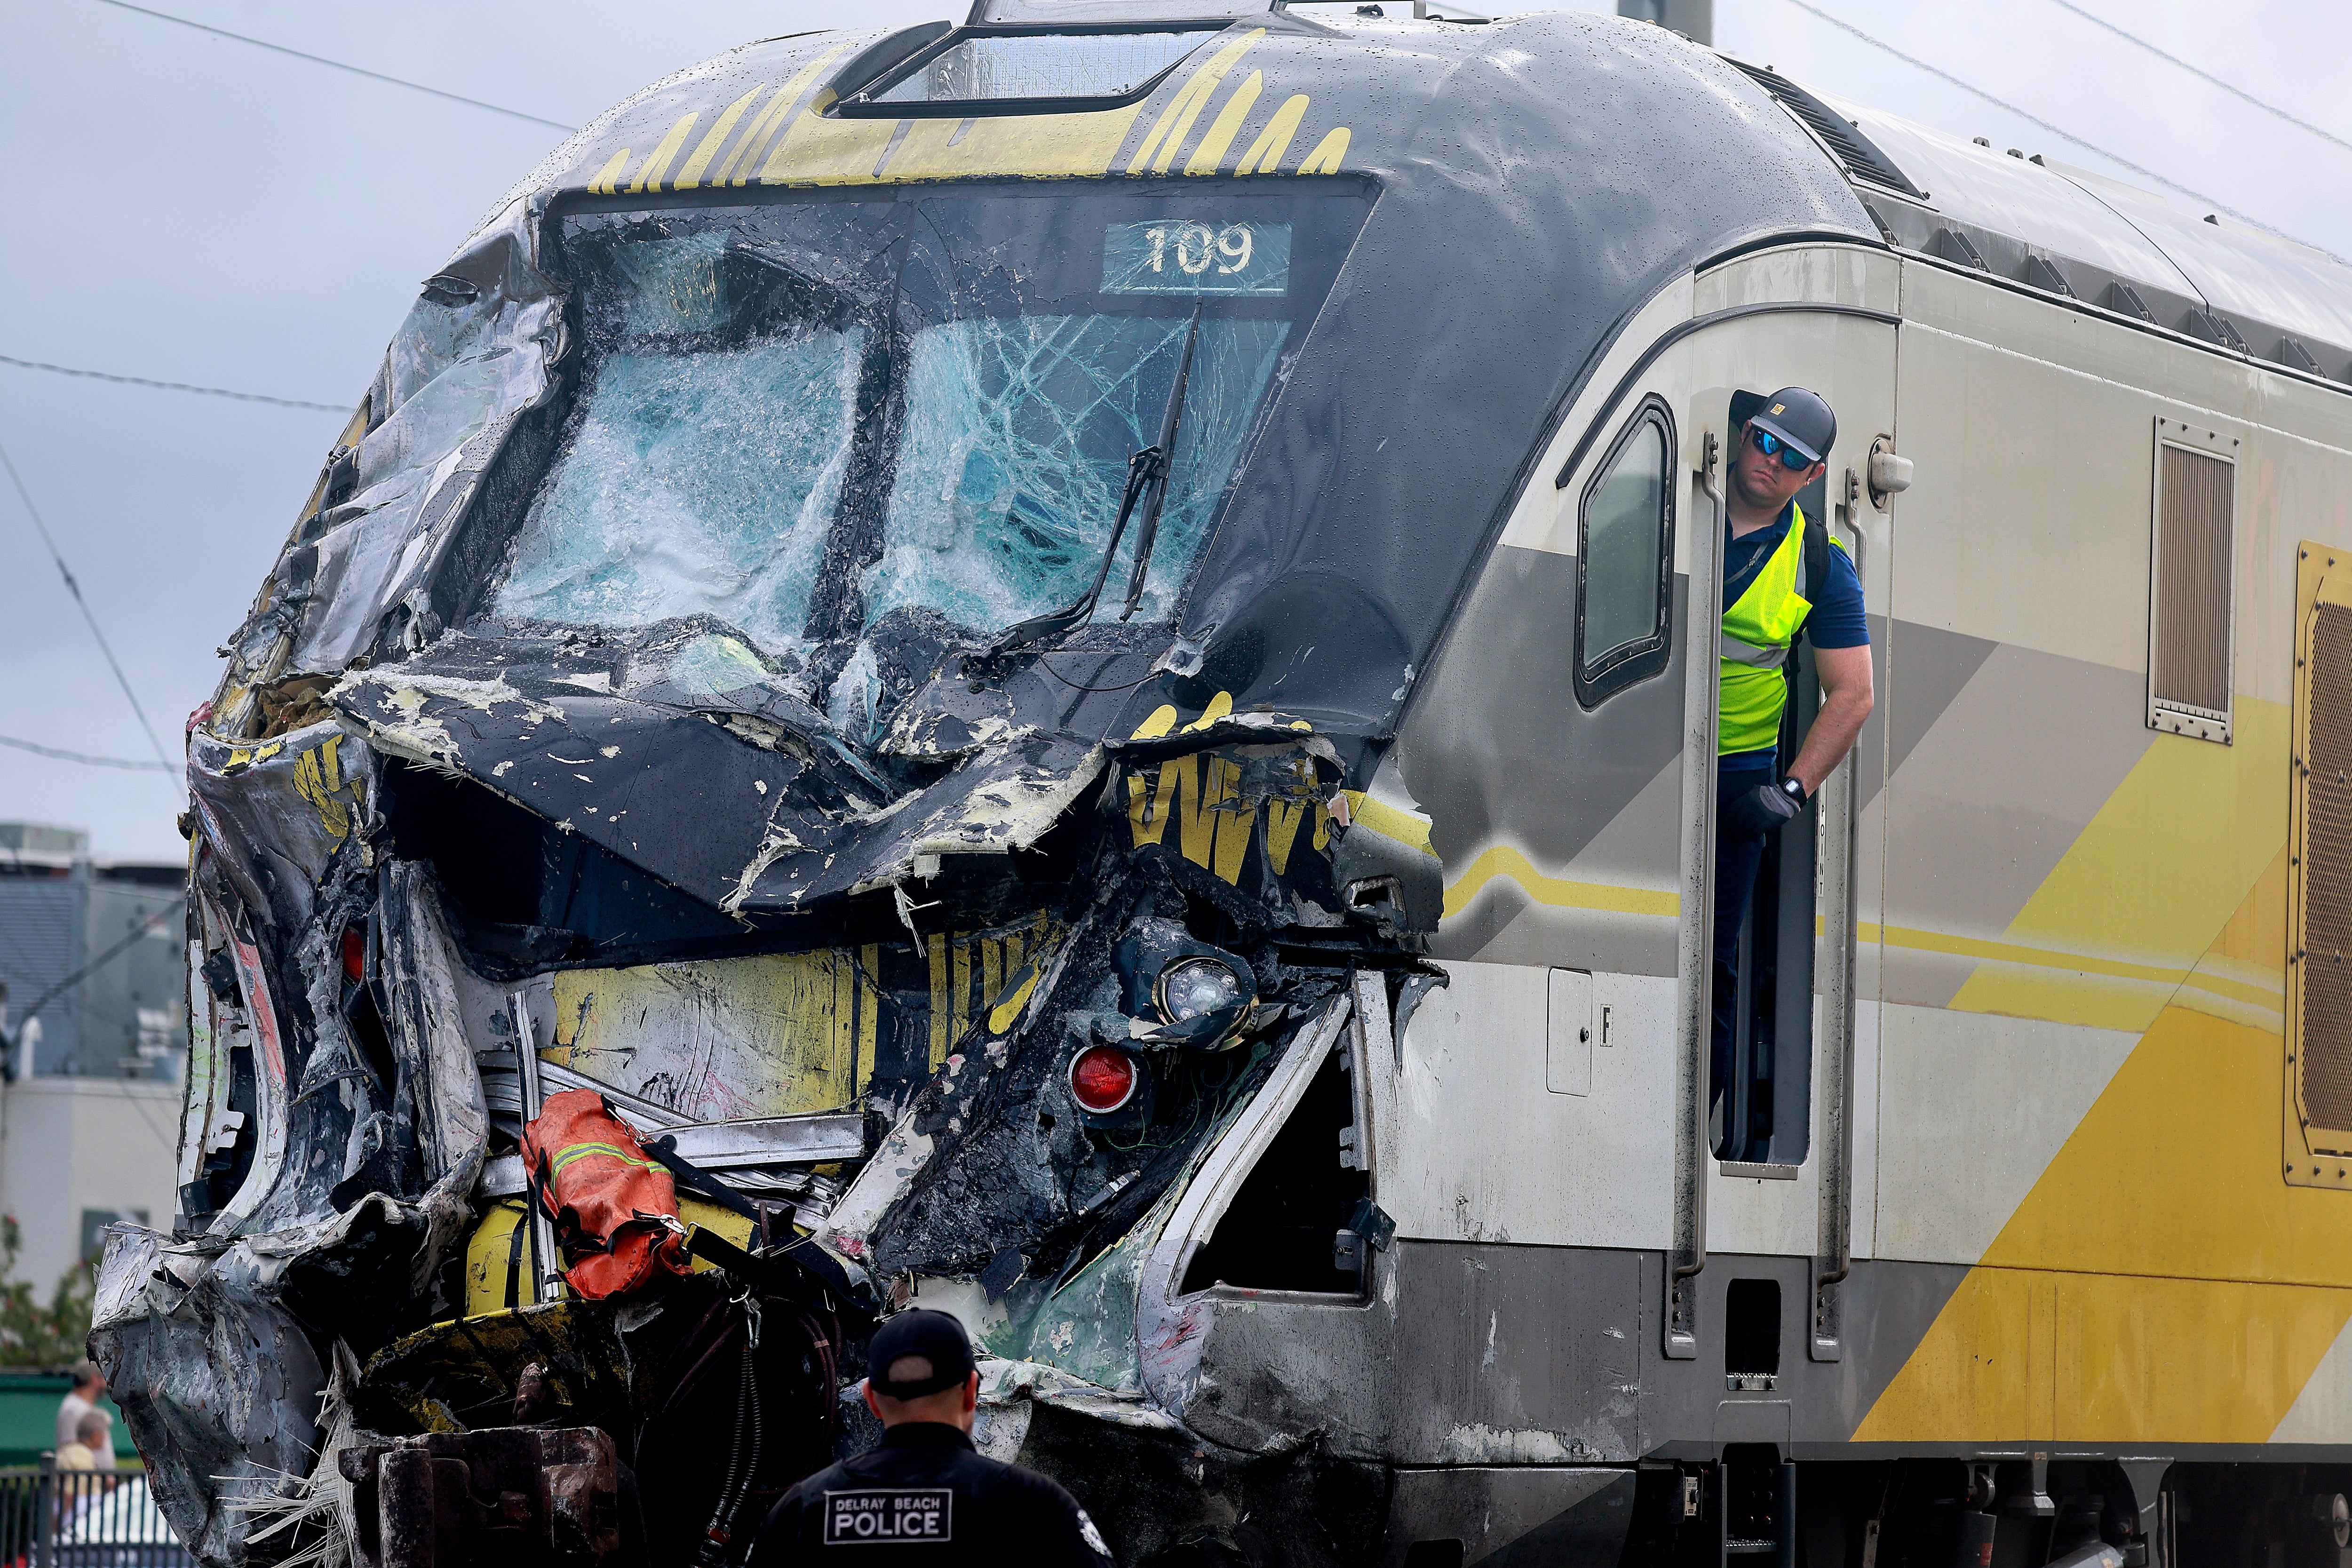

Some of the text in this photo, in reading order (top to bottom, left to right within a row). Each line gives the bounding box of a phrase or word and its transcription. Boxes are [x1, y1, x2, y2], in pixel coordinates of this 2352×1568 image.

[1145, 226, 1252, 274] 109
[1603, 1007, 1610, 1043] F
[835, 1497, 940, 1511] DELRAY BEACH
[834, 1512, 940, 1537] POLICE
